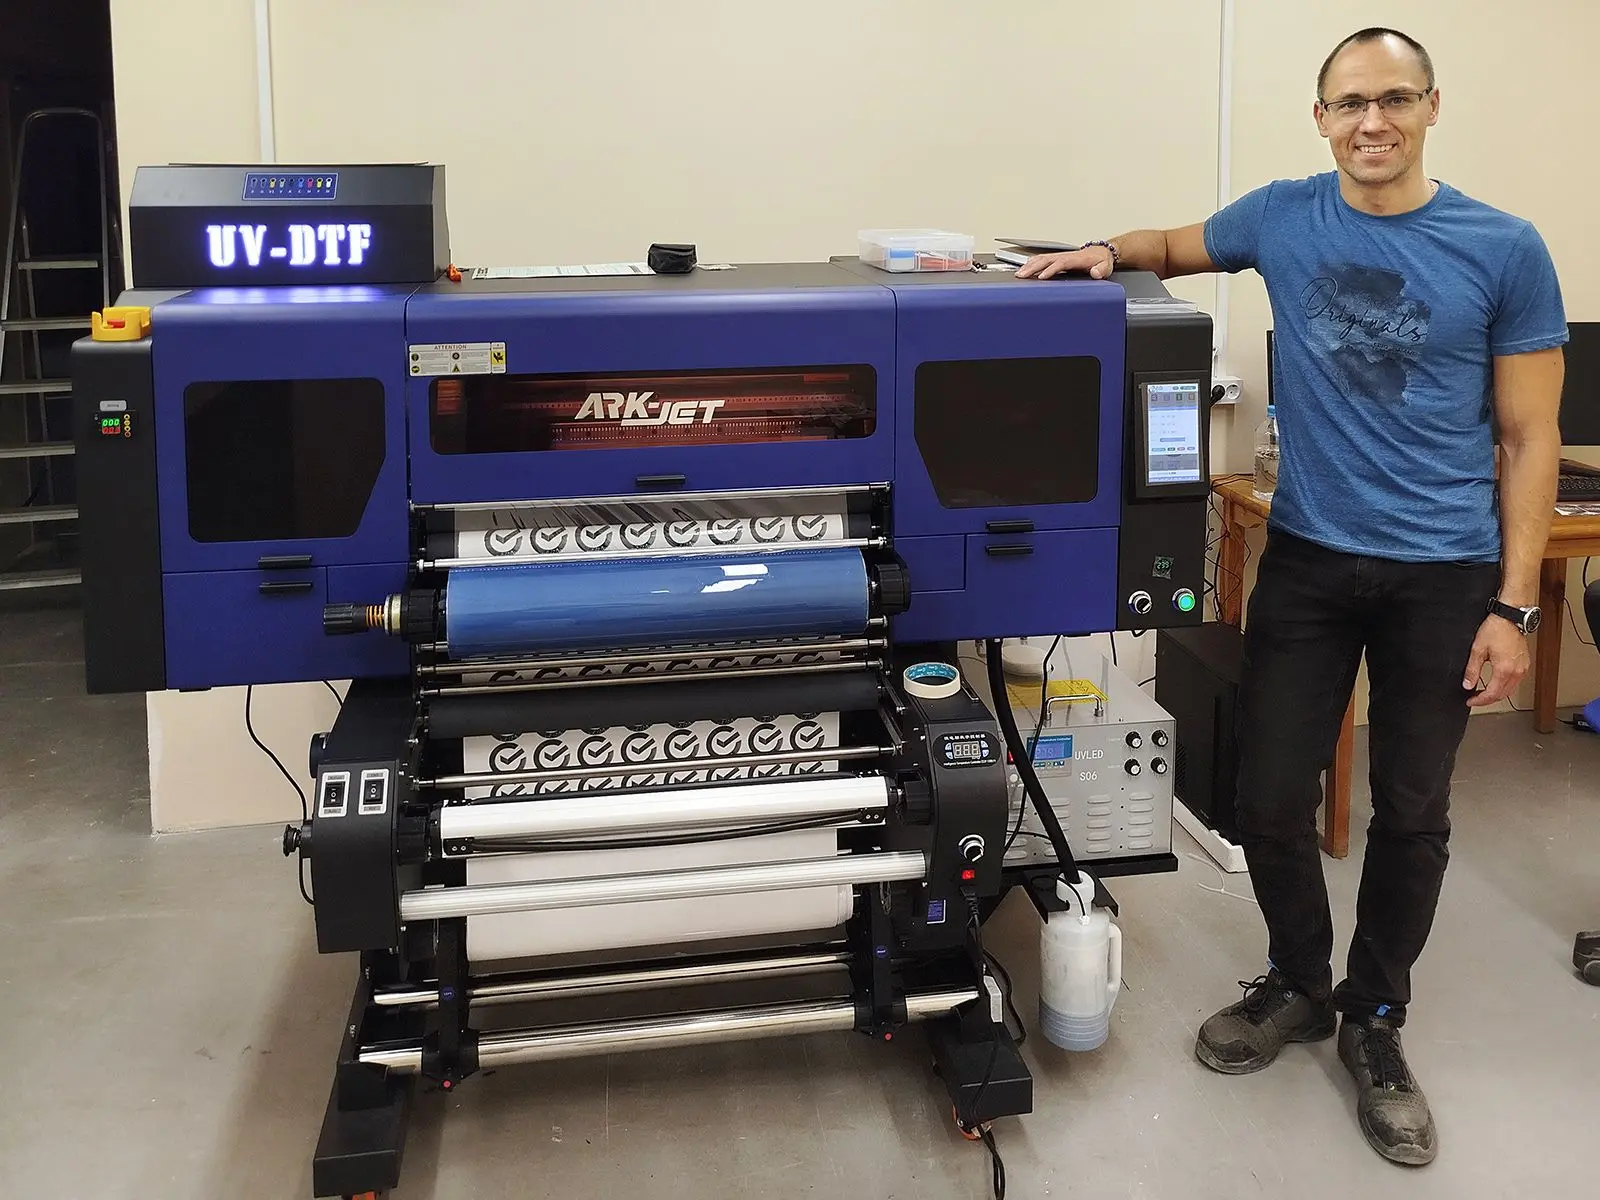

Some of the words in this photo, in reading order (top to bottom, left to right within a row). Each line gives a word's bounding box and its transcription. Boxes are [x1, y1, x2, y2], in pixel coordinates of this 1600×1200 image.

[206, 223, 372, 268] UV-DTF
[1299, 276, 1428, 342] Originals
[574, 391, 726, 427] ARK-JET
[1074, 749, 1104, 761] UVLED
[1079, 771, 1098, 781] S06
